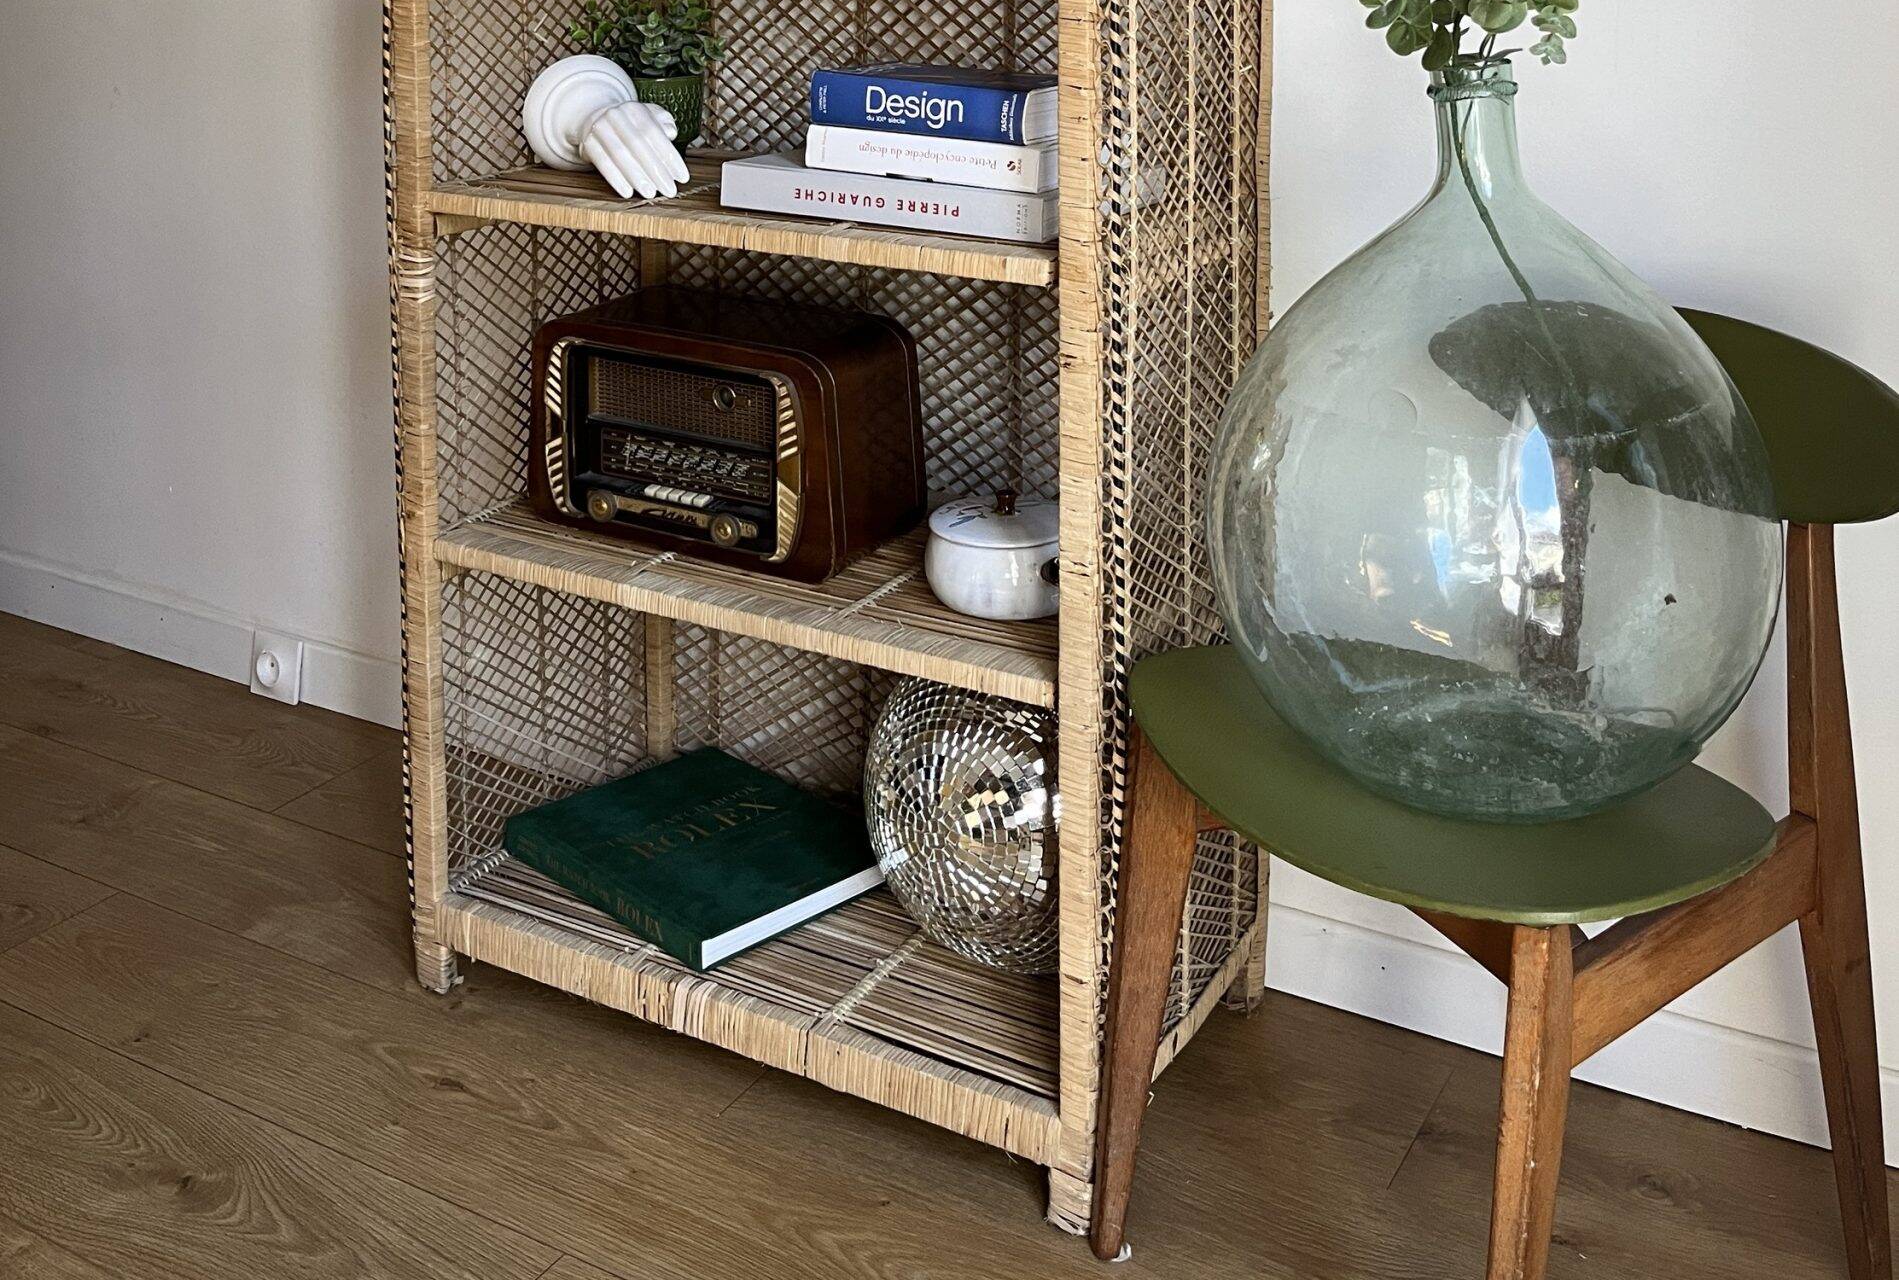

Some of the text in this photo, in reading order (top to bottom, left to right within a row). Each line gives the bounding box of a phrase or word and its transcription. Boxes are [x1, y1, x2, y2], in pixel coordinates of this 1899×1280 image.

[865, 85, 964, 129] Design
[1000, 100, 1010, 133] TASCHEN
[858, 141, 997, 170] Petite encyclopédie du design
[794, 188, 960, 217] PIERRE GUARICHE
[630, 799, 777, 861] ROLEX
